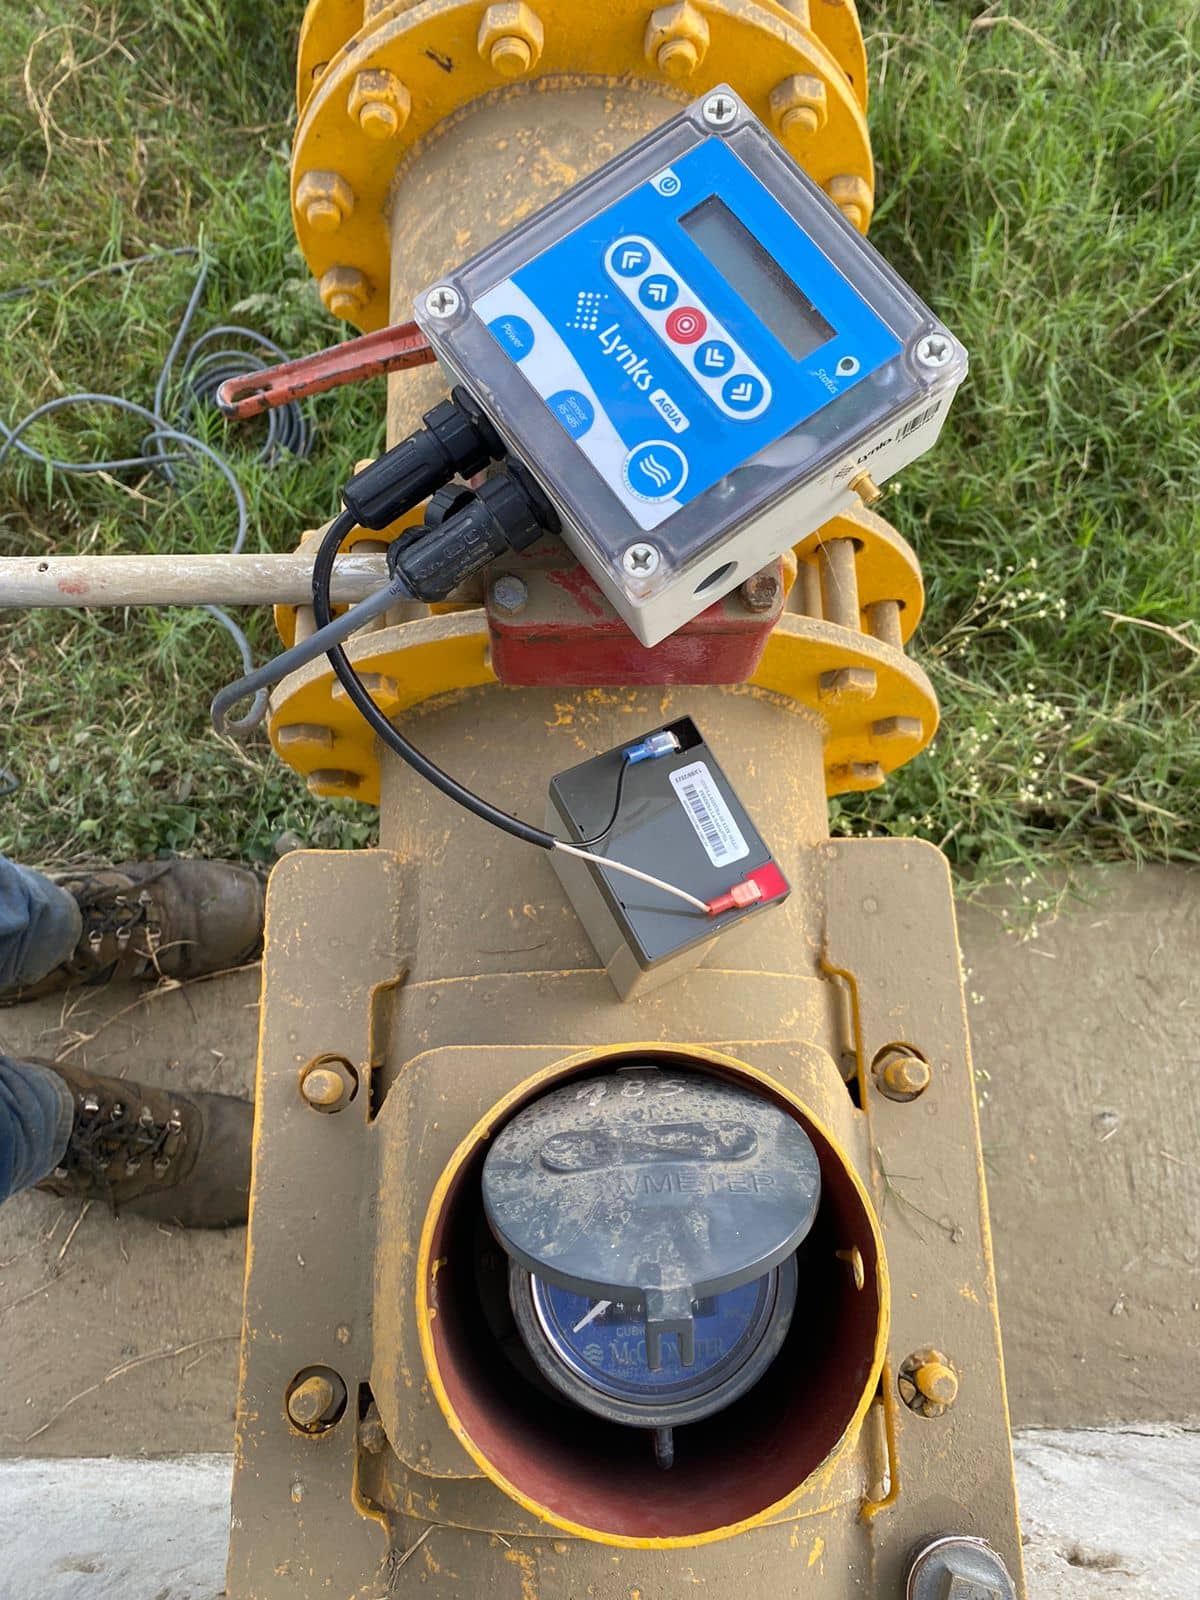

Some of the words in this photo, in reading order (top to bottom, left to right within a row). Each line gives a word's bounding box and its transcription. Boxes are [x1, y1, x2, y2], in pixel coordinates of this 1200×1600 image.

[502, 322, 524, 349] Power
[598, 322, 654, 391] Lynks
[815, 368, 839, 394] Status
[567, 396, 589, 421] Sensor
[655, 397, 683, 427] AGUA
